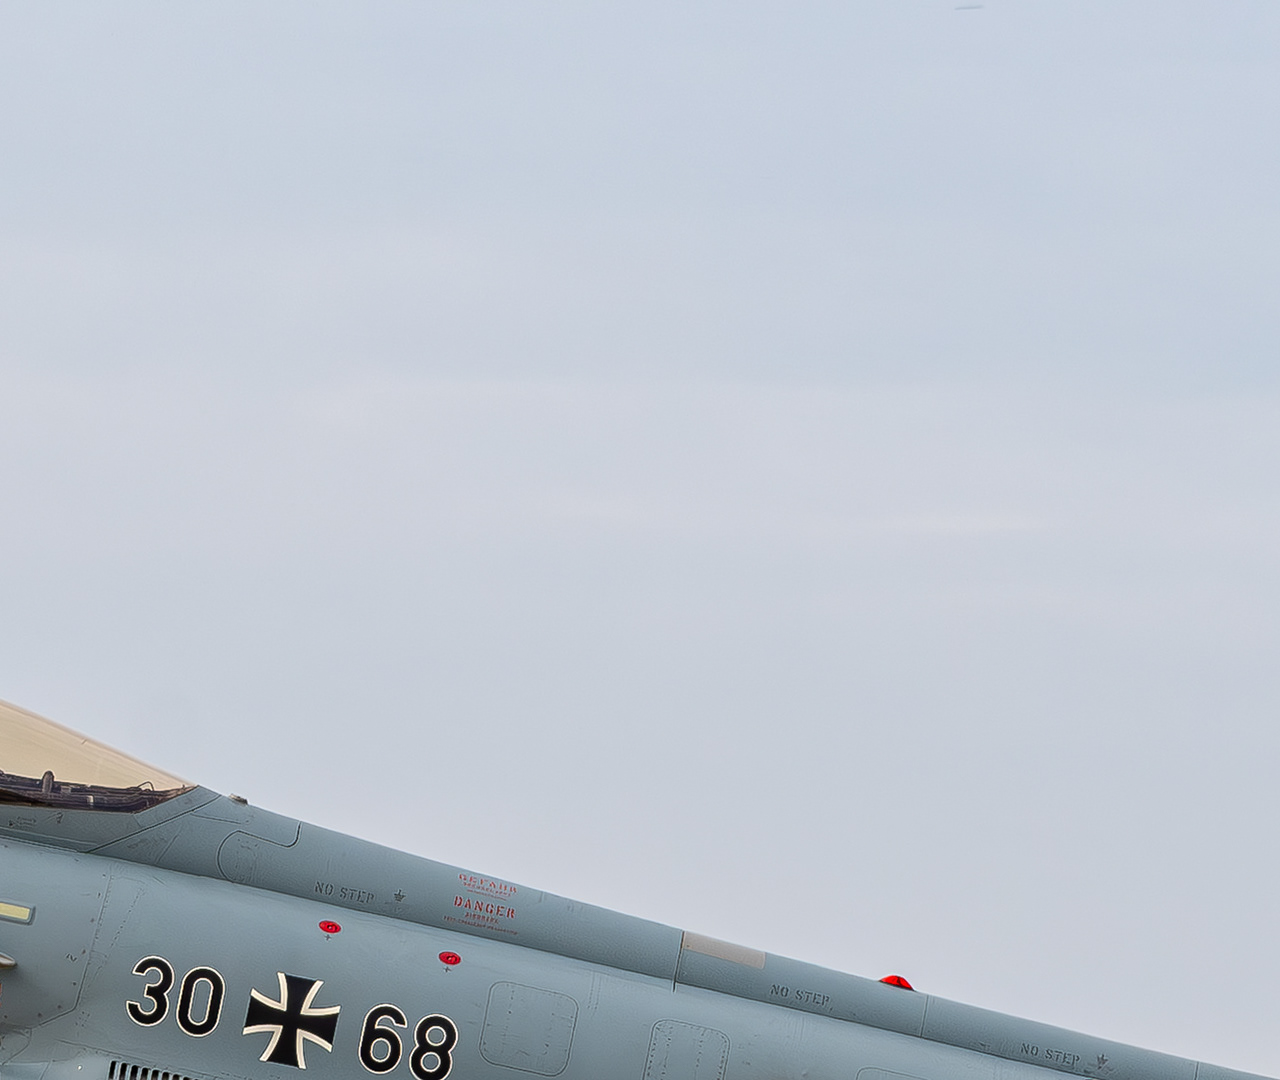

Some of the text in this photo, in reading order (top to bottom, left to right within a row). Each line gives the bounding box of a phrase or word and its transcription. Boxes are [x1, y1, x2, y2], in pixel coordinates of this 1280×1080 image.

[314, 881, 376, 904] NO STEP
[453, 896, 516, 919] DANGER
[126, 955, 226, 1038] 30
[770, 984, 831, 1006] NO STEP
[1021, 1042, 1081, 1066] NO STEP
